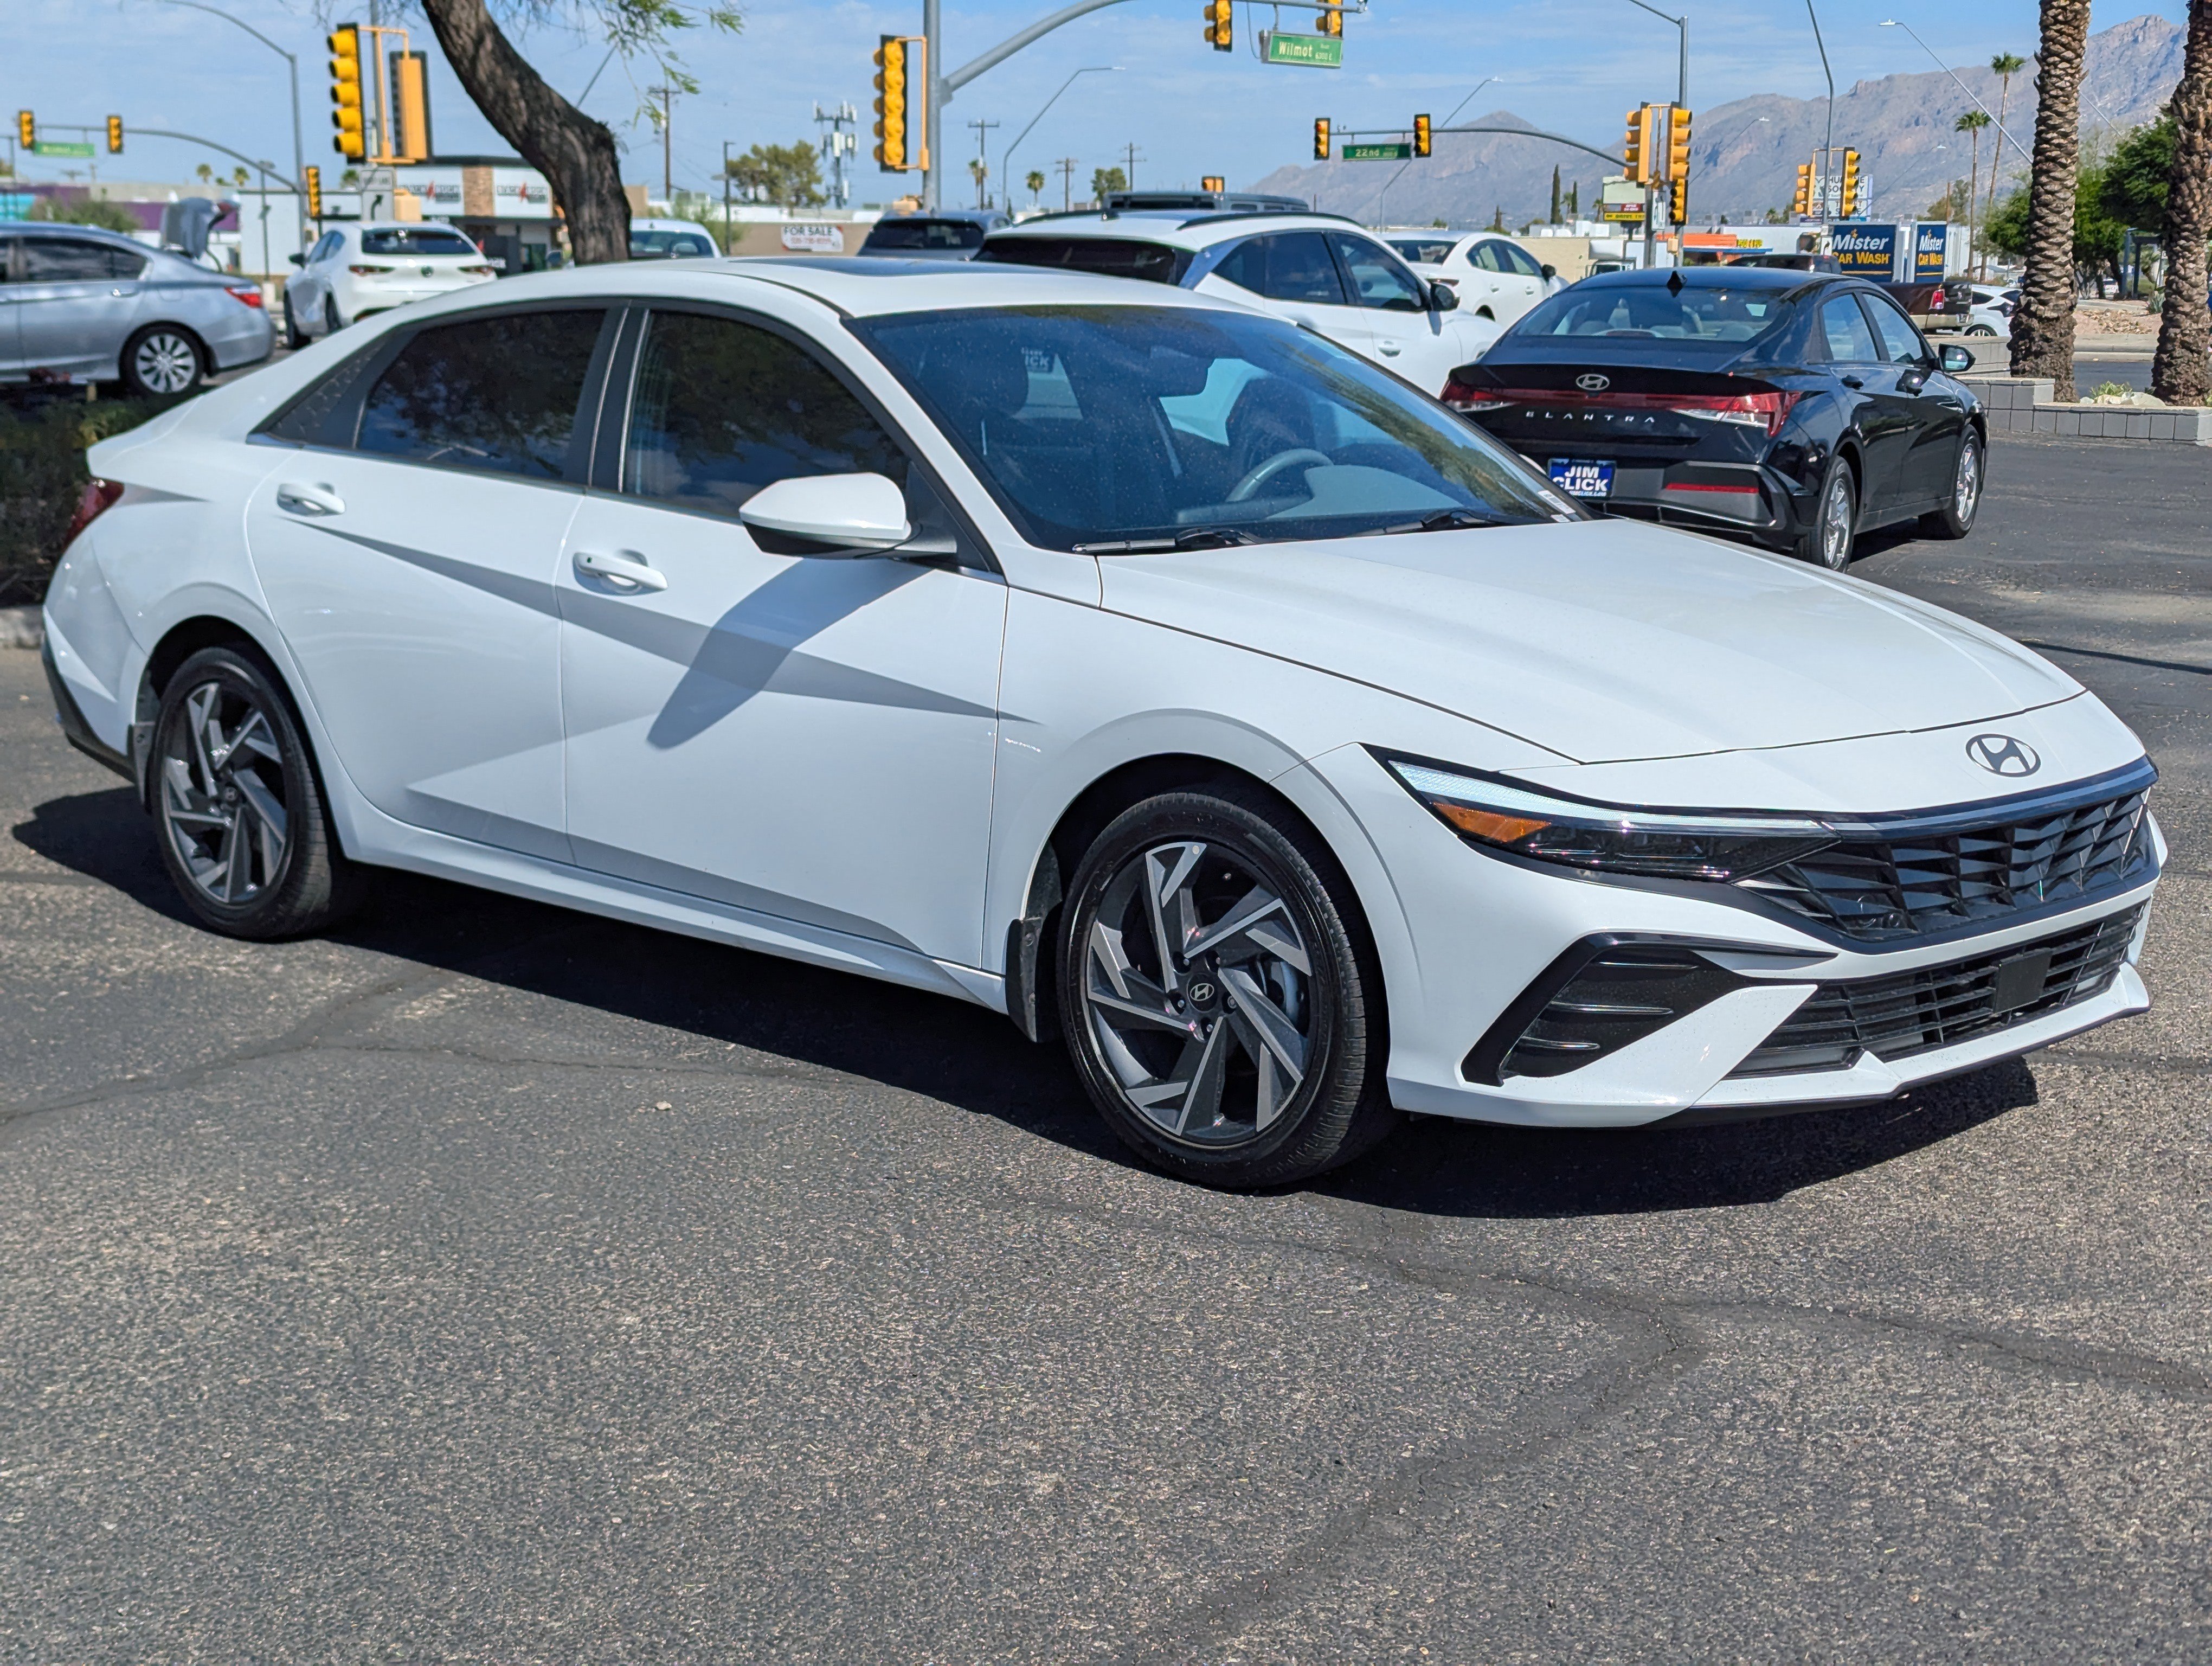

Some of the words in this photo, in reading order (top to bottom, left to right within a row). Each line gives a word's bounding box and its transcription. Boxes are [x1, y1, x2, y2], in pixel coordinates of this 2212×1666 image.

[1278, 41, 1313, 57] Wilmot
[1355, 148, 1380, 157] 22nd
[784, 227, 805, 236] FOR
[808, 227, 833, 236] SALE
[1832, 233, 1889, 250] Mister
[1918, 234, 1944, 251] Mister
[1856, 251, 1889, 264] WASH
[1918, 253, 1928, 266] CAR
[1929, 253, 1943, 265] WASH
[1526, 411, 1655, 423] ELANTRA
[1564, 466, 1600, 478] JIM
